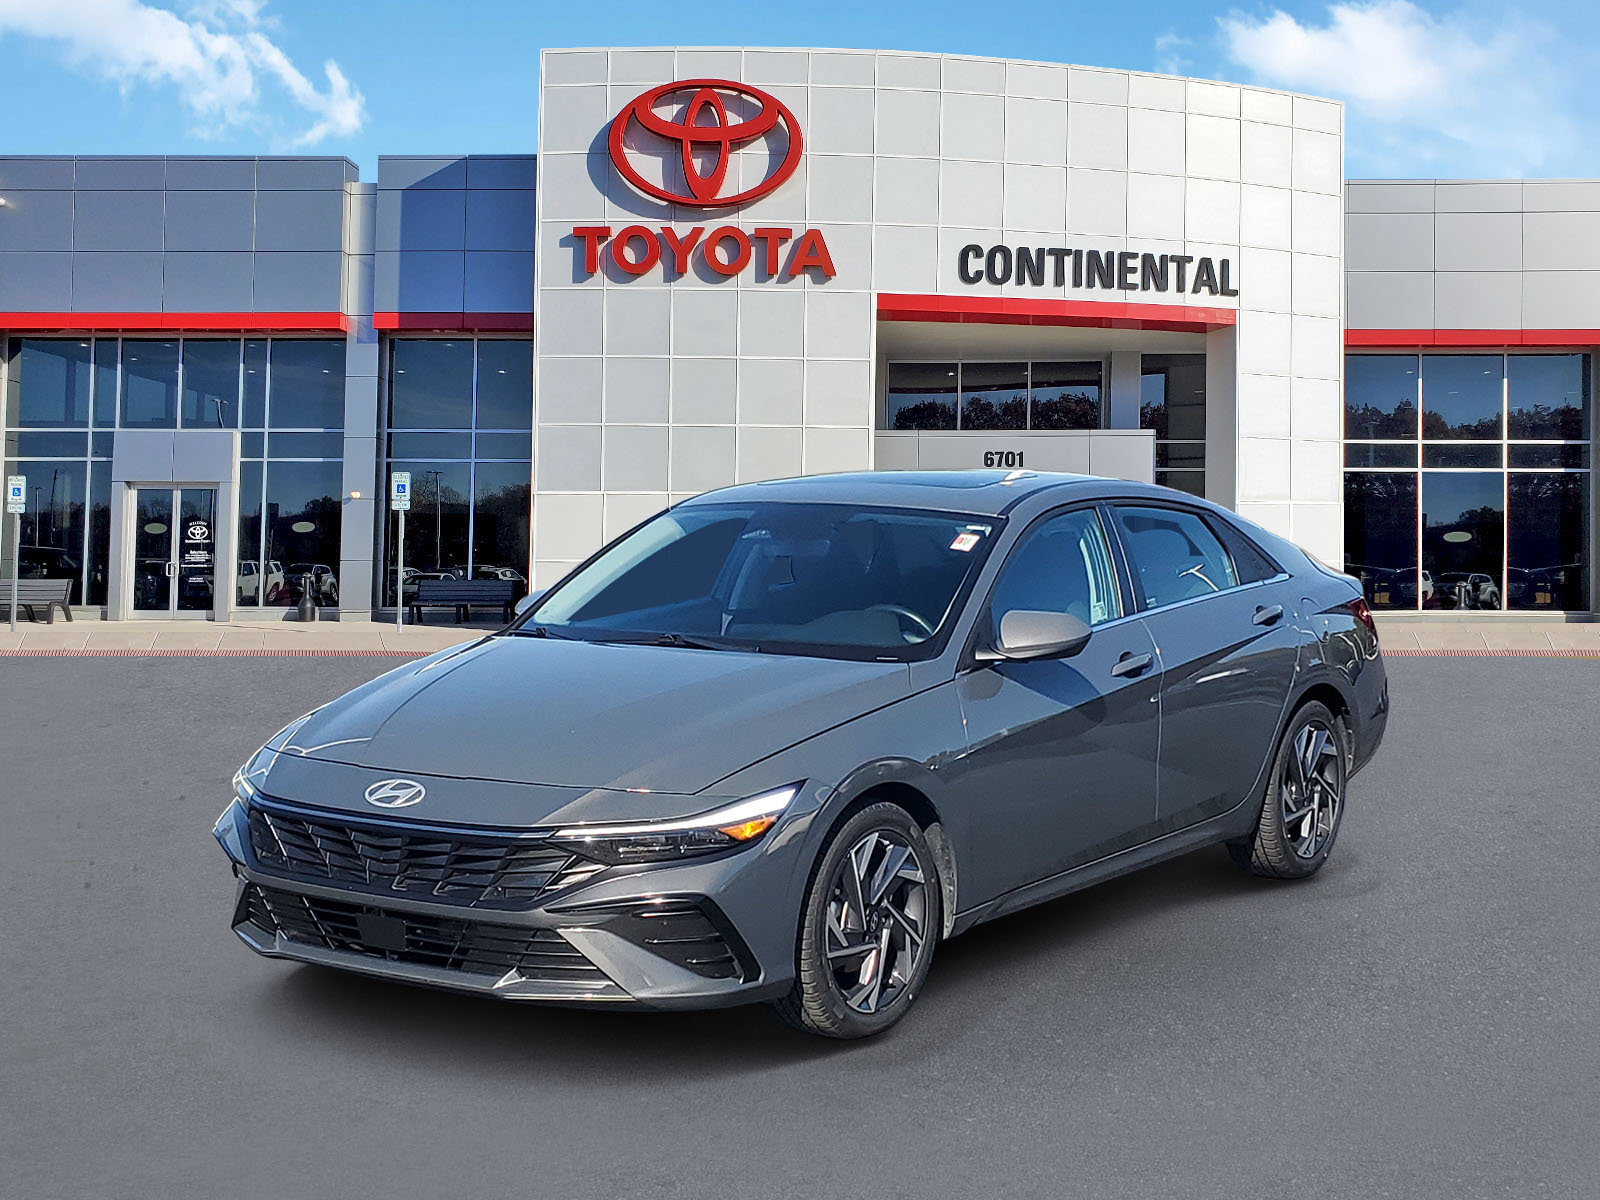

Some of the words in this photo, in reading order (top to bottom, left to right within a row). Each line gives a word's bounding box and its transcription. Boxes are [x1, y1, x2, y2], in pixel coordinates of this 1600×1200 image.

[573, 225, 837, 276] TOYOTA
[958, 244, 1239, 297] CONTINENTAL
[983, 450, 1024, 468] 6701
